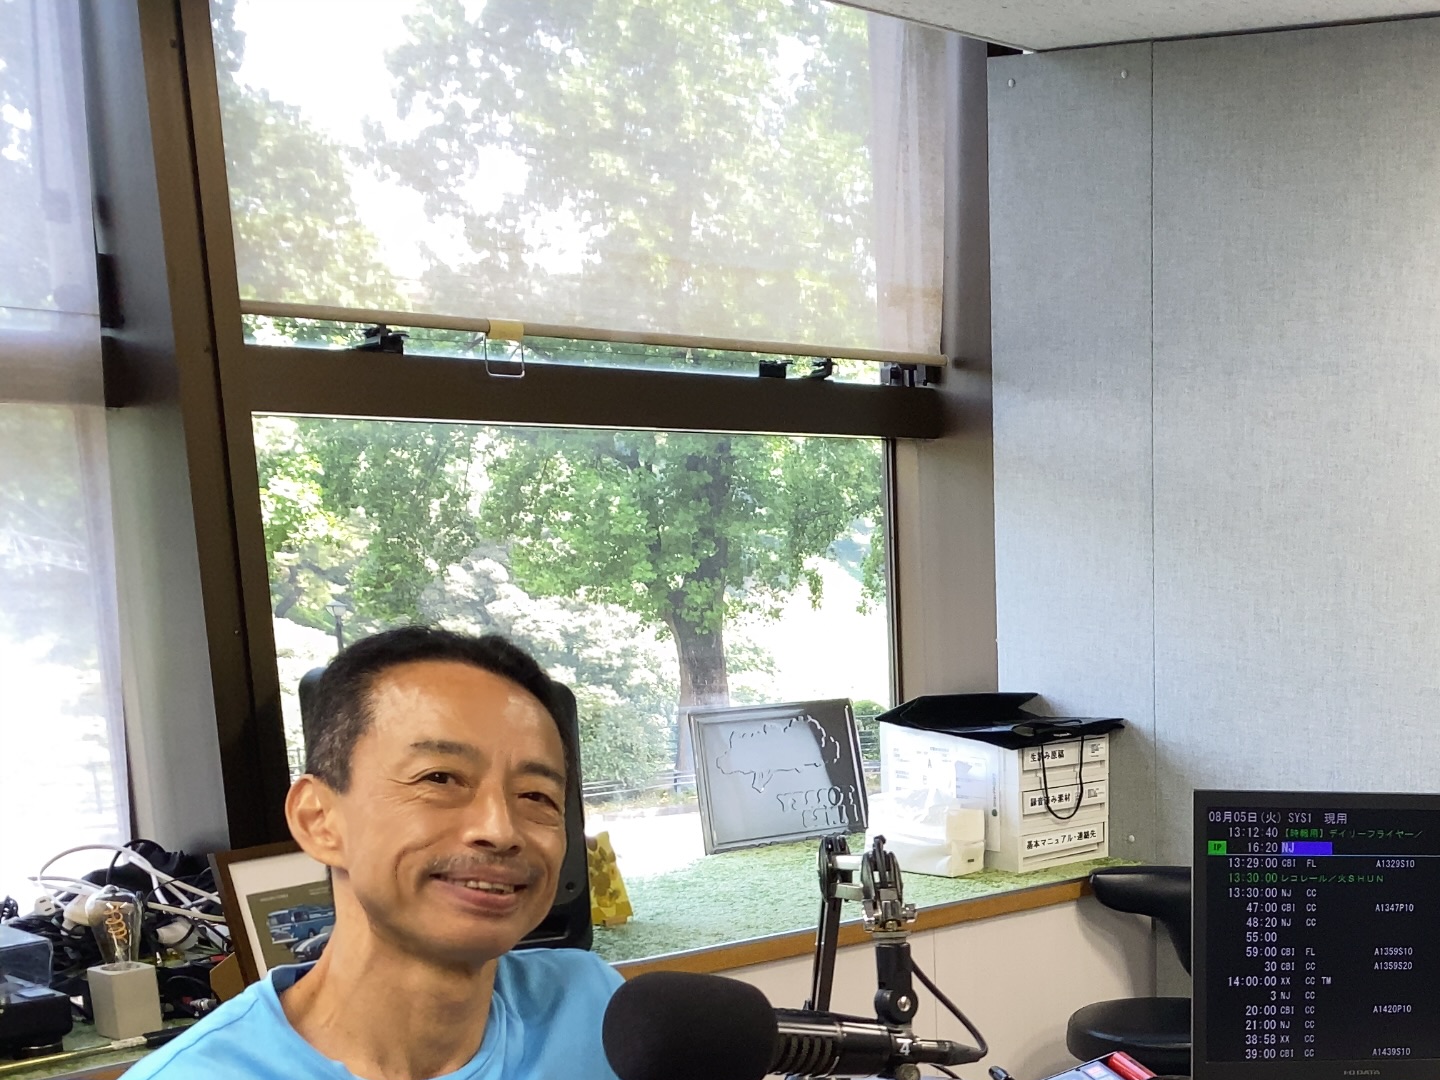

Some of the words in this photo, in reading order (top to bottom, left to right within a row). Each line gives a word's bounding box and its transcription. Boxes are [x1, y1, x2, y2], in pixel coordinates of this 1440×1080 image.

[1288, 812, 1312, 824] SYS1
[1324, 812, 1347, 824] 現用
[1228, 827, 1278, 838] 13:12:40
[1247, 842, 1278, 853] 16:20
[1282, 842, 1295, 853] NJ
[1228, 858, 1277, 868] 13:29:00
[1281, 860, 1296, 868] CBI
[1306, 860, 1316, 868] FL
[1376, 860, 1415, 868] A1329S10
[1228, 873, 1277, 883] 13:30:00
[1228, 888, 1277, 898] 13:30:00
[1281, 889, 1291, 897] NJ
[1306, 889, 1316, 897] CC
[1246, 903, 1277, 912] 47:00
[1281, 904, 1295, 912] CBI
[1306, 904, 1316, 912] CC
[1375, 904, 1414, 912] A1347P10
[1246, 918, 1277, 927] 48:20
[1281, 919, 1291, 927] NJ
[1306, 919, 1316, 927] CC
[1246, 932, 1277, 942] 55:00
[1246, 947, 1277, 957] 59:00
[1281, 948, 1295, 956] CBI
[1306, 948, 1315, 956] FL
[1265, 962, 1277, 972] 30
[1281, 963, 1295, 971] CBI
[1305, 962, 1315, 970] CC
[1374, 962, 1413, 970] A1359S20
[1228, 977, 1276, 986] 14:00:00
[1305, 977, 1315, 985] CC
[1271, 991, 1276, 1000] 3
[1281, 992, 1291, 1000] NJ
[1246, 1006, 1276, 1016] 20:00
[1281, 1006, 1294, 1014] CBI
[1305, 1006, 1315, 1014] CC
[1373, 1005, 1411, 1013] A1420P10
[1246, 1020, 1276, 1030] 21:00
[1280, 1021, 1290, 1029] NJ
[1245, 1034, 1276, 1044] 38:58
[1305, 1035, 1314, 1043] CC
[900, 1042, 910, 1056] 4
[1246, 1049, 1276, 1059] 39:00
[1280, 1049, 1294, 1058] CBI
[1304, 1049, 1314, 1057] CC
[1372, 1048, 1411, 1056] A1439S10
